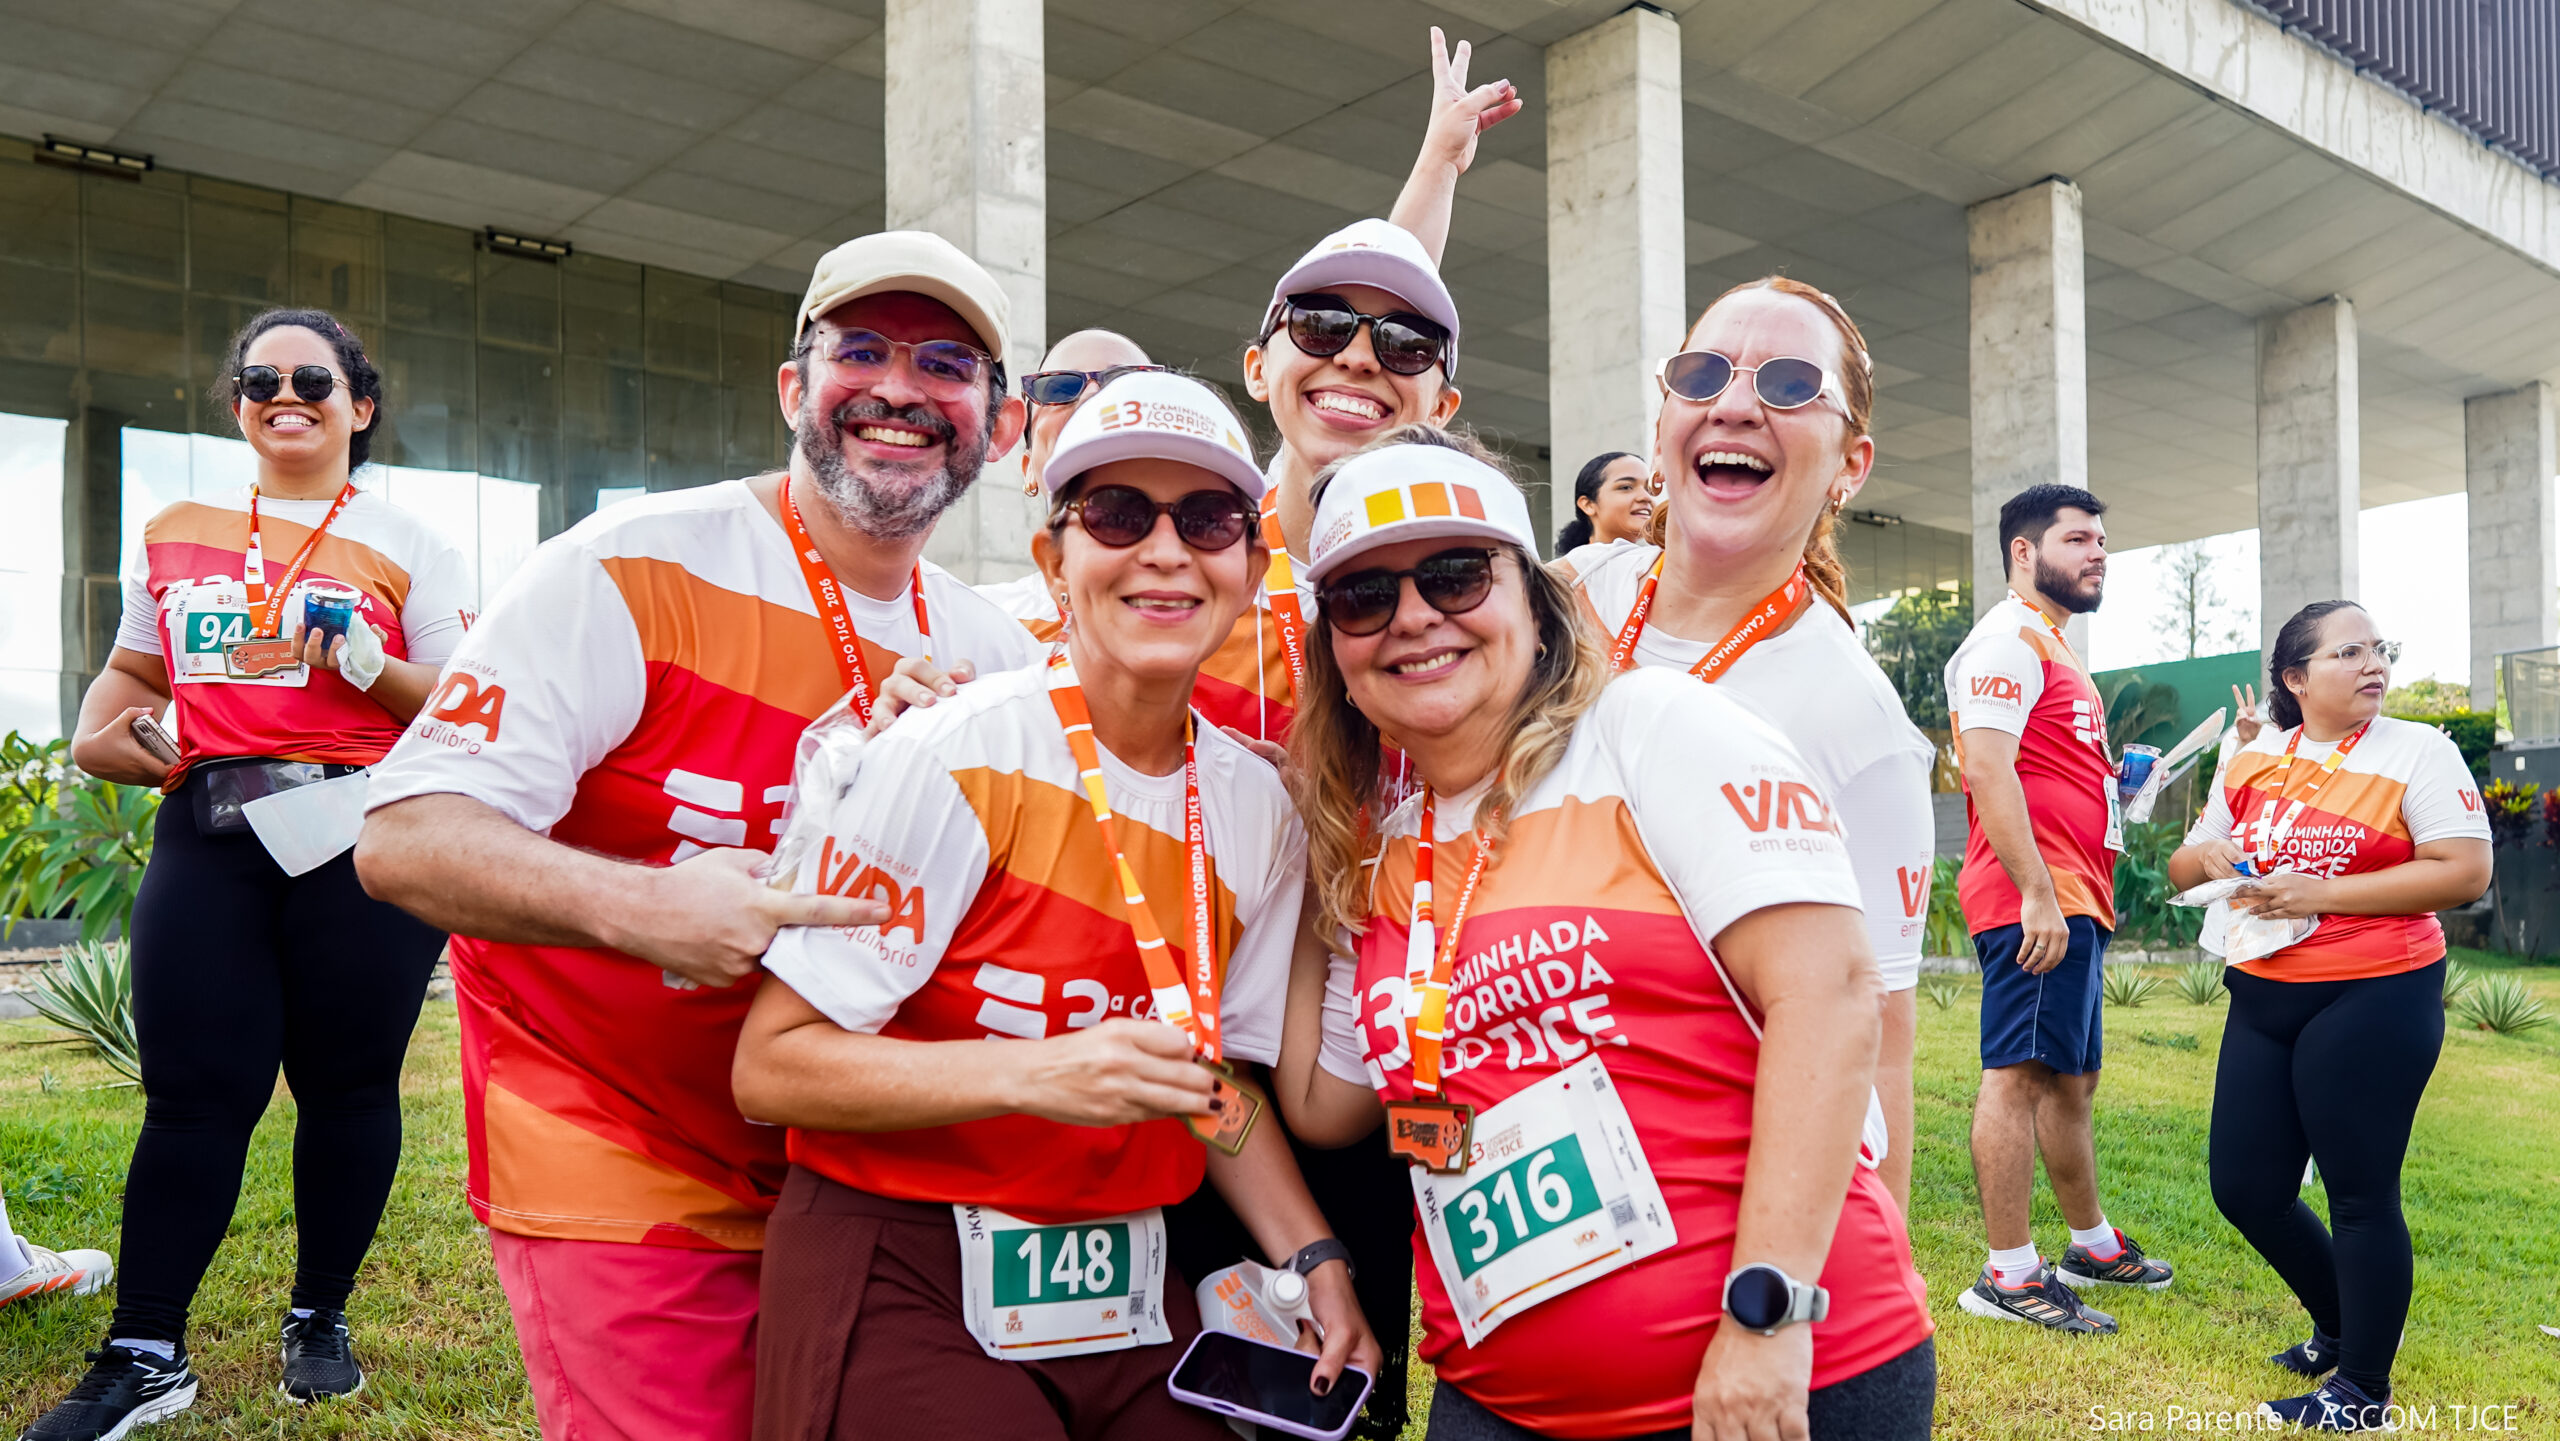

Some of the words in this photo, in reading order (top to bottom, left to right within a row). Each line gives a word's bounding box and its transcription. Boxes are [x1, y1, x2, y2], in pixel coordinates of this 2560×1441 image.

[1151, 403, 1218, 428] CAMINHADA
[819, 578, 839, 608] 2026
[199, 614, 260, 650] 94
[833, 614, 850, 642] TJCE
[1610, 652, 1624, 669] DO
[1621, 625, 1638, 651] TJCE
[1634, 594, 1651, 621] 2026
[842, 644, 858, 664] DO
[1971, 675, 2022, 707] VIDA
[1188, 795, 1201, 821] TJCE
[1190, 823, 1202, 842] DO
[1750, 838, 1781, 853] em
[2284, 826, 2366, 840] AMINHADA
[1191, 844, 1212, 982] CAMINHADA/CORRIDA
[1450, 914, 1610, 996] AMINHADA
[1485, 993, 1630, 1072] TJCE
[1424, 1186, 1439, 1225] 3KM
[1458, 1148, 1573, 1264] 316
[966, 1205, 984, 1241] 3KM
[1017, 1228, 1114, 1299] 148
